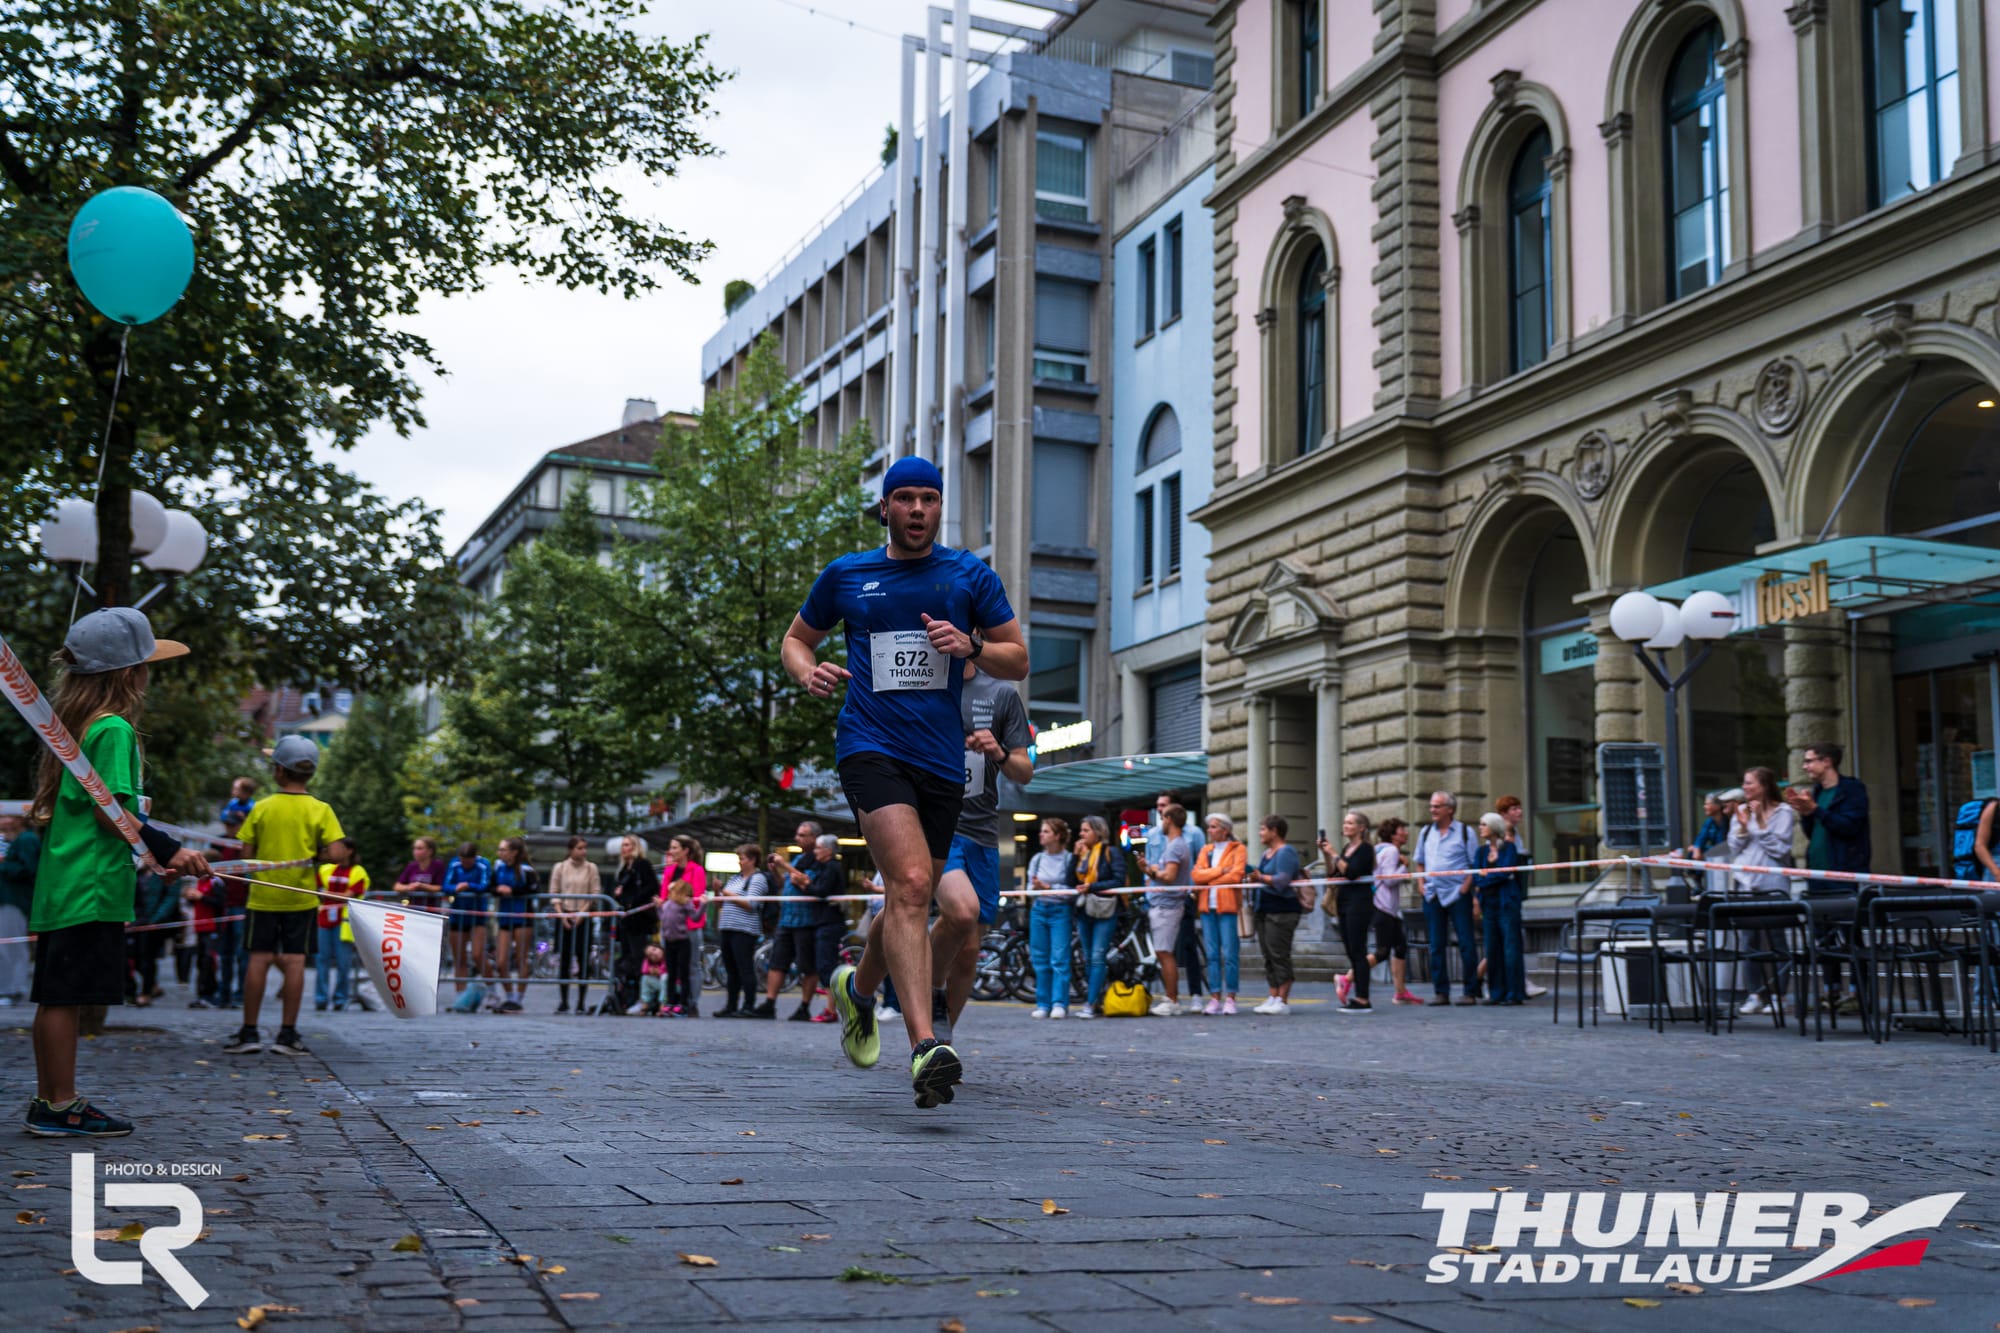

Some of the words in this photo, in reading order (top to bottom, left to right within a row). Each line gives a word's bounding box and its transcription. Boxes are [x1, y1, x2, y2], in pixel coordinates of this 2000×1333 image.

[894, 651, 929, 667] 672
[889, 669, 934, 678] THOMAS
[381, 912, 405, 1010] MIGROS
